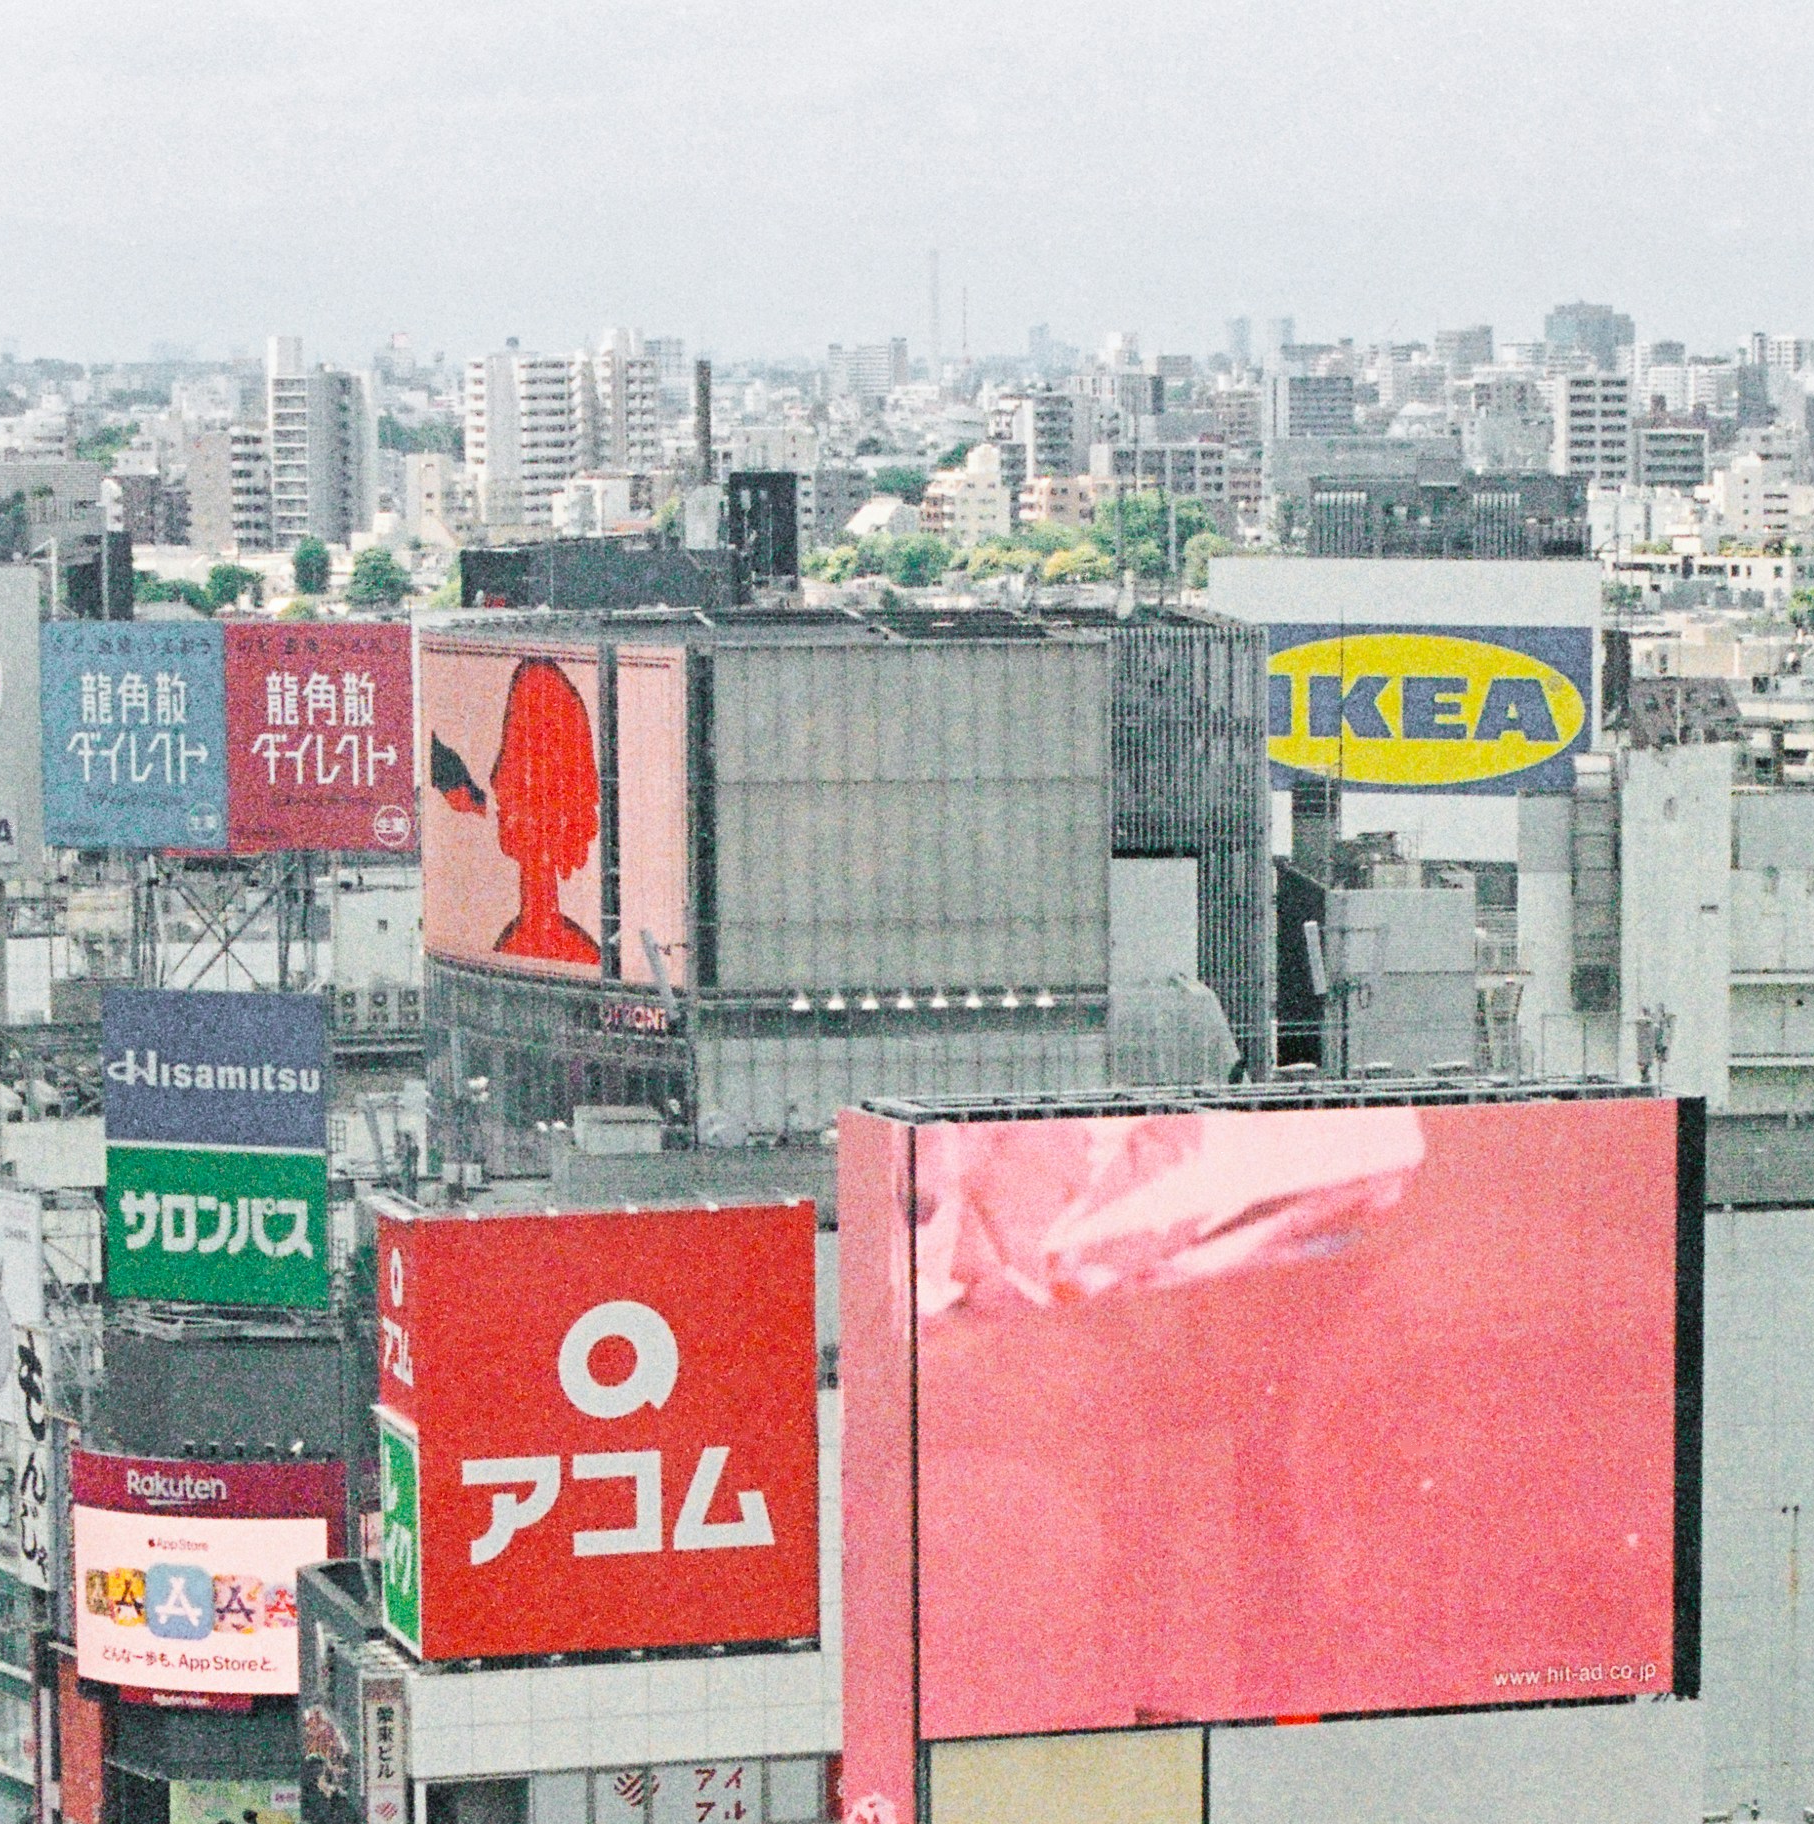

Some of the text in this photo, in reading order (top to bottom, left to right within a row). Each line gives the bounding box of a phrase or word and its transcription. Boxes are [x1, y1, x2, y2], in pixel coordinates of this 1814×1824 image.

[80, 673, 188, 725] 龍角散
[266, 673, 375, 725] 龍角散
[1269, 675, 1561, 743] IKEA
[107, 1051, 321, 1094] Hisamitsu
[119, 1190, 313, 1260] サロンパス
[126, 1469, 228, 1500] Rakuten
[462, 1445, 776, 1566] アコム
[157, 1538, 209, 1553] App Store
[178, 1653, 210, 1673] App
[1493, 1662, 1657, 1687] www.hit-ad.co.jp
